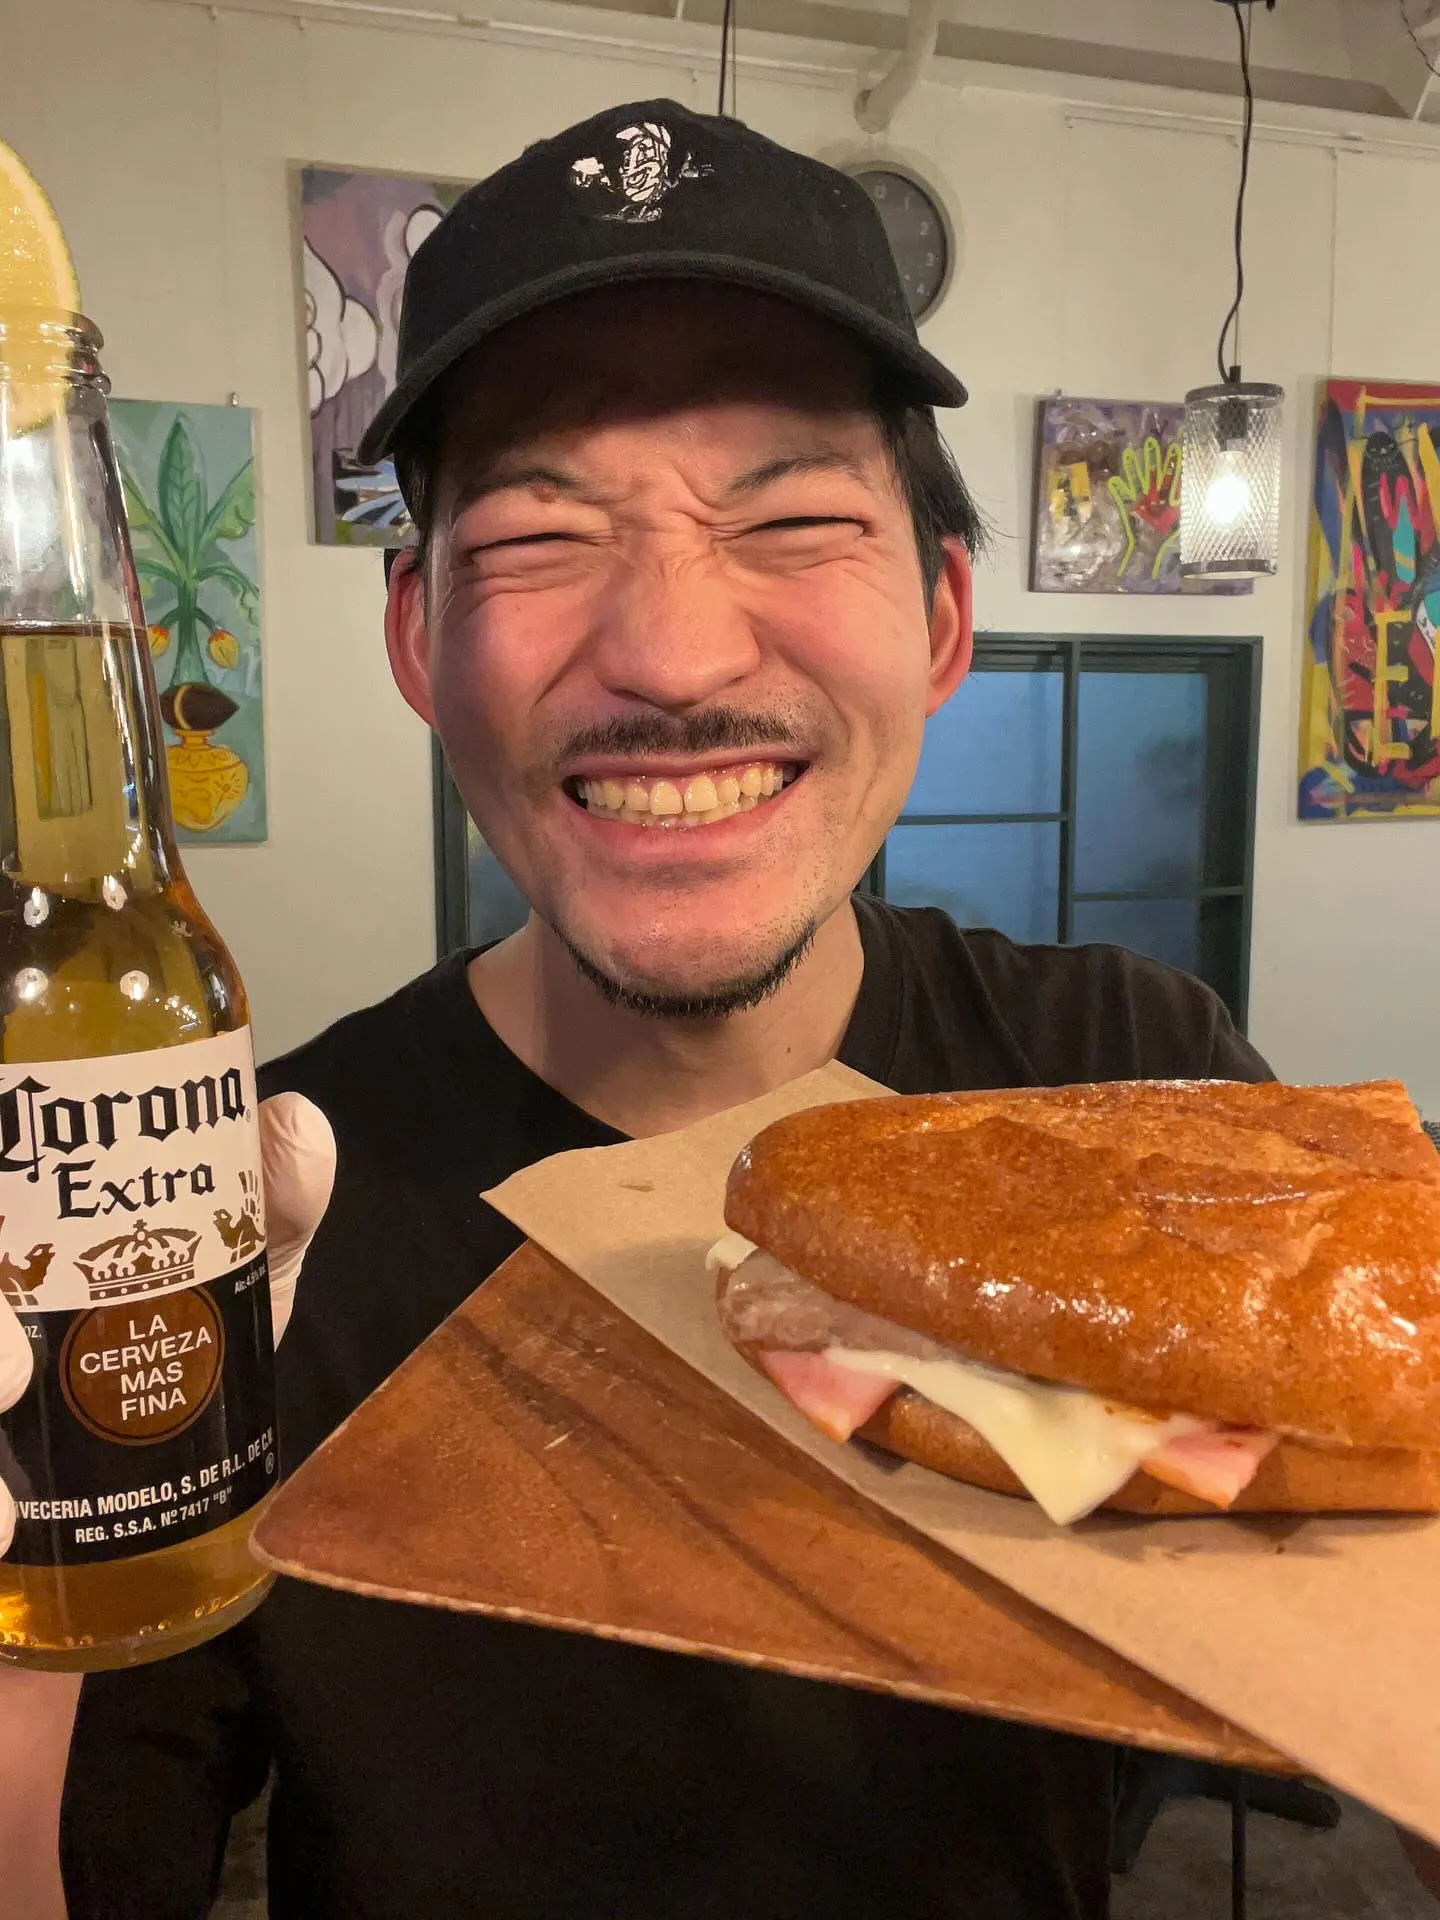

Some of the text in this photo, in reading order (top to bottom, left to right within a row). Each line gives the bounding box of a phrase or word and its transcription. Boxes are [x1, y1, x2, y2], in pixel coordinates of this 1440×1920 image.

[0, 1067, 246, 1184] Corona
[51, 1159, 216, 1220] Extra
[79, 1326, 212, 1375] CERVEZA
[129, 1314, 168, 1341] LA
[120, 1361, 184, 1395] MAS
[120, 1387, 187, 1421] FINA
[16, 1499, 93, 1520] VECERIA
[97, 1483, 178, 1516] MODELO,
[180, 1475, 197, 1496] S.
[199, 1464, 219, 1489] DE
[221, 1454, 246, 1479] R.L.
[248, 1439, 261, 1463] DE
[75, 1526, 109, 1544] REG.
[113, 1517, 157, 1539] S.S.A.
[179, 1498, 209, 1524] 7417
